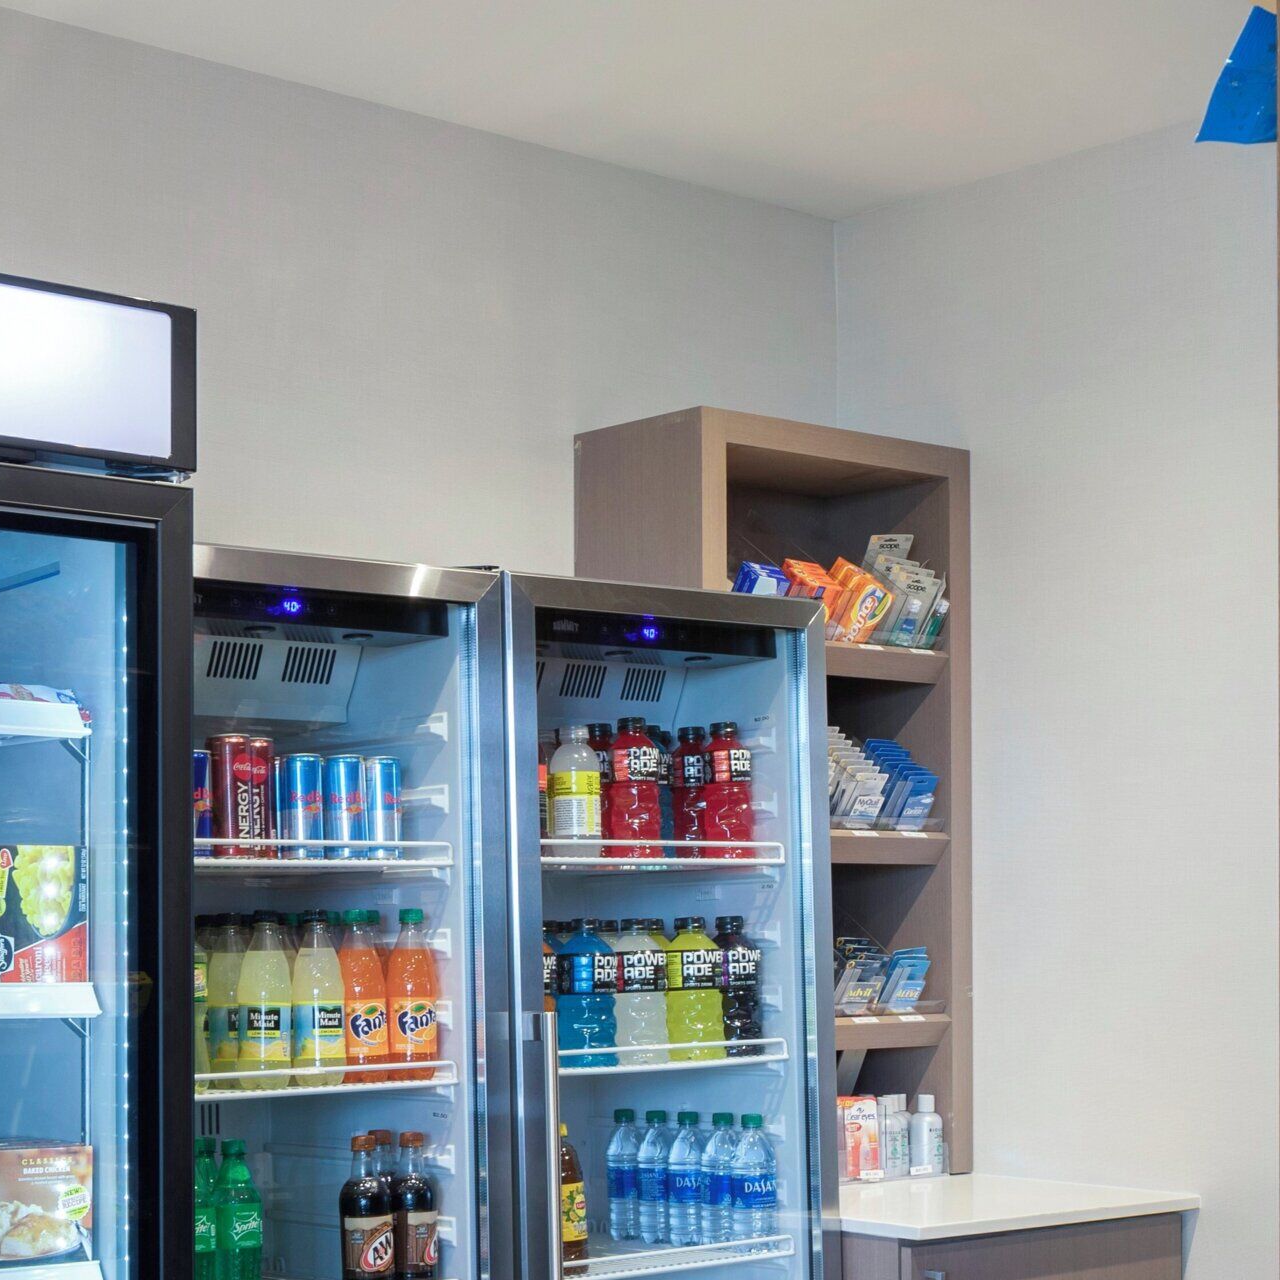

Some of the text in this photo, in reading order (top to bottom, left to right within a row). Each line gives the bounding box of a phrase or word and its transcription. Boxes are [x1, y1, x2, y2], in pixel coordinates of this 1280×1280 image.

[879, 543, 900, 551] scope
[906, 583, 927, 592] scope
[629, 759, 657, 771] ADE
[731, 760, 751, 771] ADE
[238, 782, 250, 849] ENERGY
[624, 966, 655, 980] ADE
[683, 963, 714, 977] ADE
[729, 962, 756, 975] ADE
[320, 1018, 339, 1026] Maid
[23, 1167, 43, 1175] BAKED
